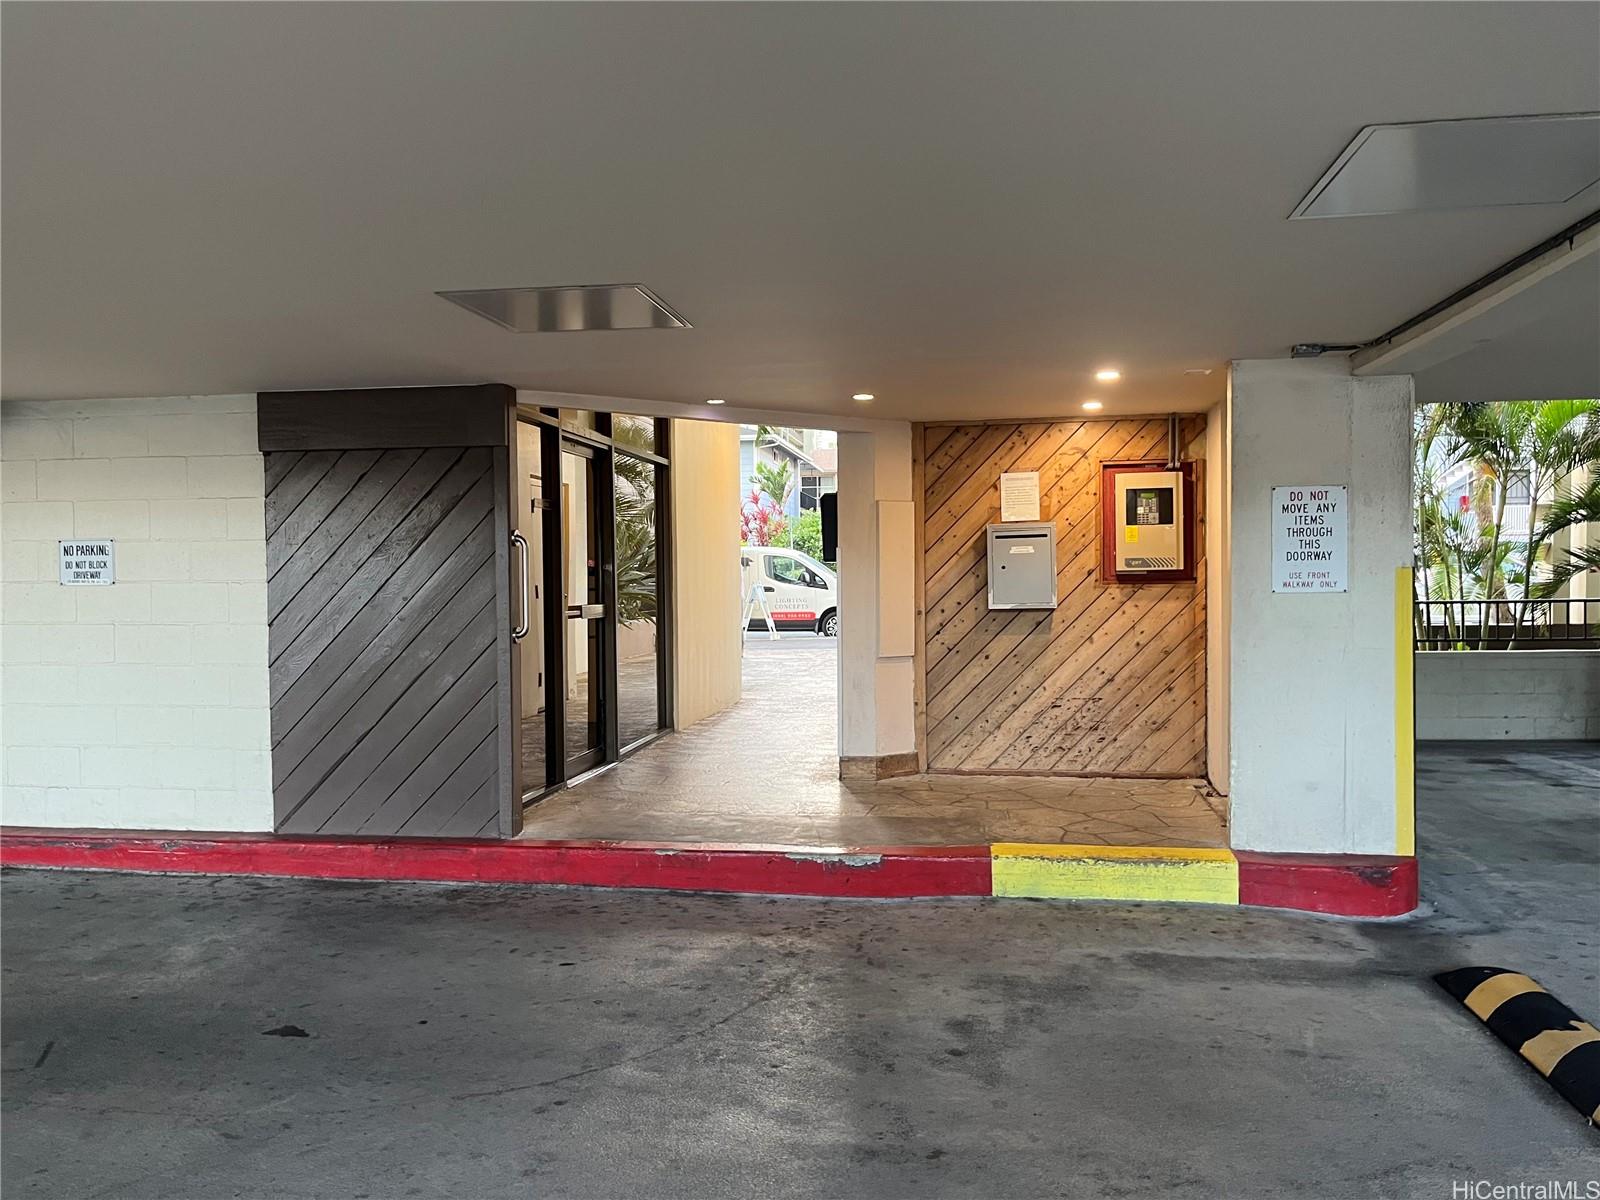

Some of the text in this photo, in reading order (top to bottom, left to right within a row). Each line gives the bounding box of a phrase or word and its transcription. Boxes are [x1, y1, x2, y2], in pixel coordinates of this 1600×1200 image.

[1290, 491, 1329, 501] DO NOT
[1282, 503, 1337, 513] MOVE ANY
[1295, 515, 1324, 525] ITEMS
[1287, 527, 1333, 537] THROUGH
[1299, 539, 1320, 549] THIS
[63, 545, 110, 556] NO PARKING
[1286, 551, 1333, 561] DOORWAY
[65, 561, 108, 569] DO NOT BLOCK
[73, 571, 101, 579] DRIVEWAY
